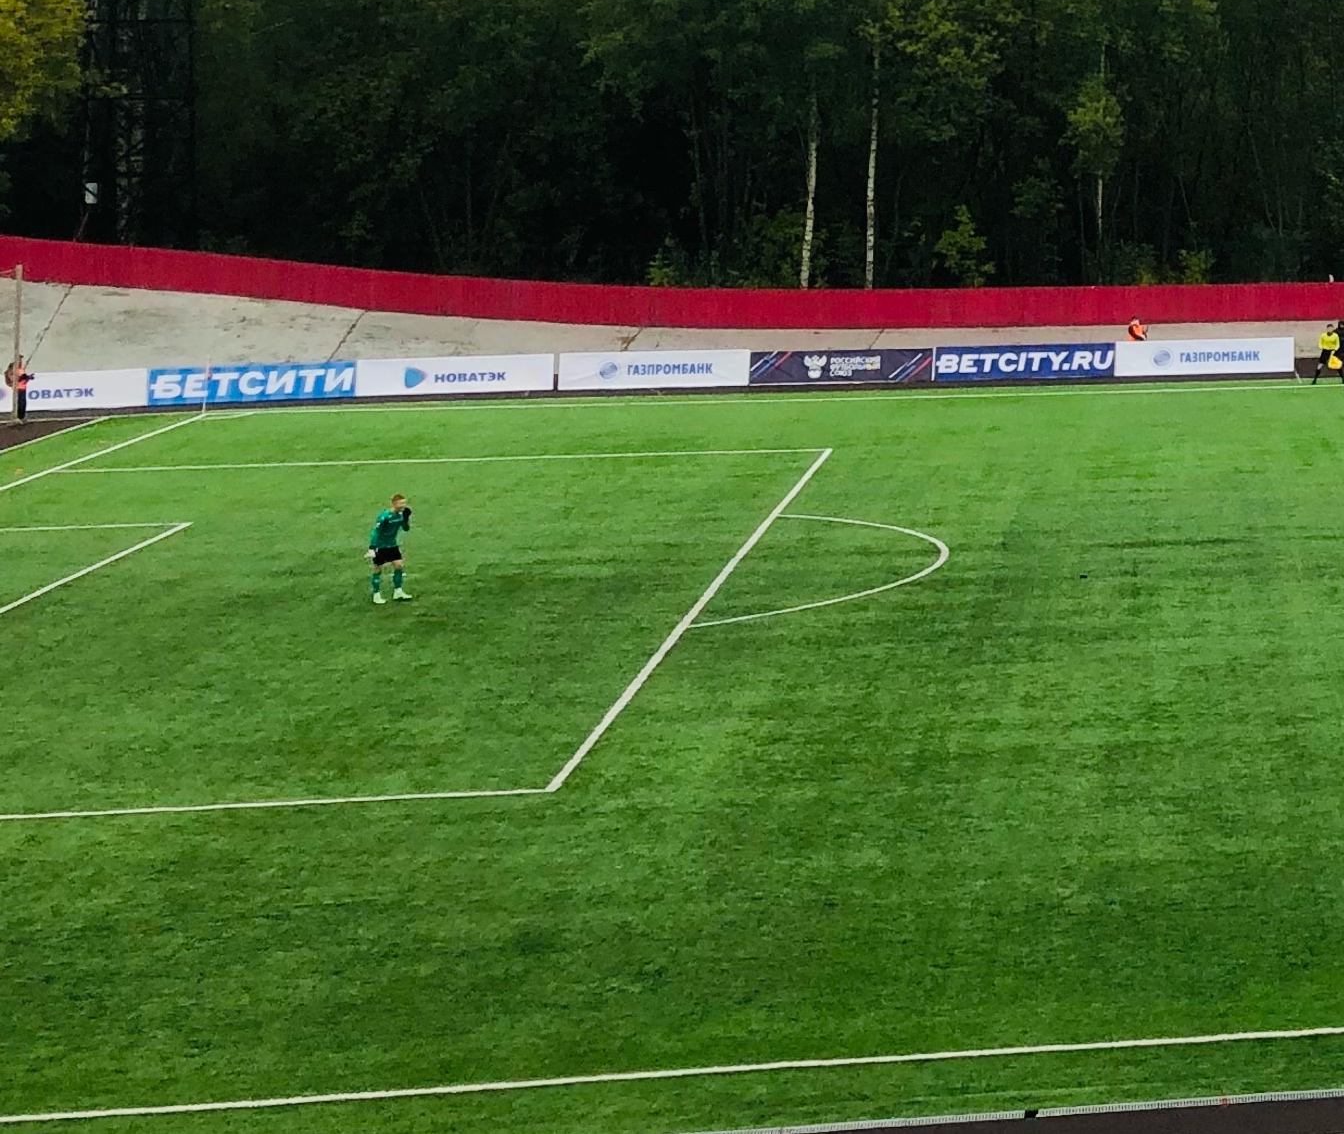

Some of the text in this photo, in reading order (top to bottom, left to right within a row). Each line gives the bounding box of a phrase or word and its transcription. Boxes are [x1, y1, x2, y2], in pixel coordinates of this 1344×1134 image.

[936, 350, 1115, 374] BETCITY.RU
[1180, 351, 1260, 363] ГАЗПРОМБАНК
[627, 363, 713, 376] ГАЗПРОМБАНК
[151, 367, 355, 400] БЕТСИТИ
[434, 371, 507, 383] НОВАТЭК
[28, 387, 94, 400] ОВАТЭК
